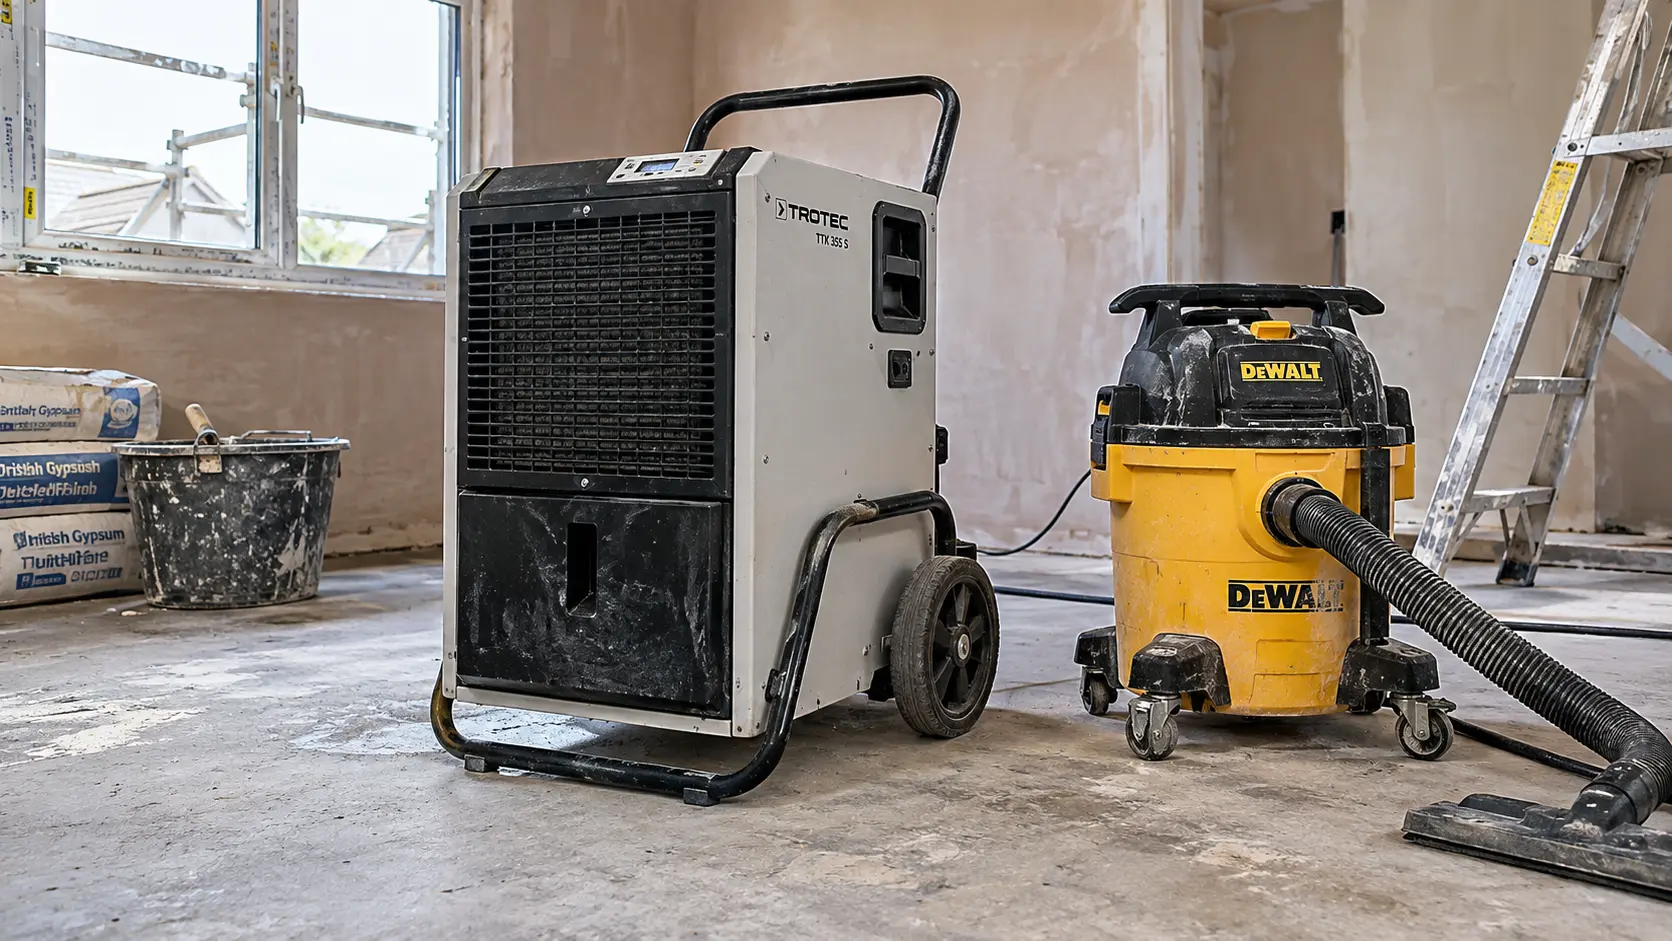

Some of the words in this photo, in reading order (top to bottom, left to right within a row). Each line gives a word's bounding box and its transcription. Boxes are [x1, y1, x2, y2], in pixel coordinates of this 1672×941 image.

[788, 203, 849, 231] TROTEC
[816, 232, 830, 246] TTK
[830, 236, 843, 249] 355
[843, 239, 849, 249] S
[1240, 363, 1321, 379] DEWALT
[72, 529, 125, 545] Gypsum
